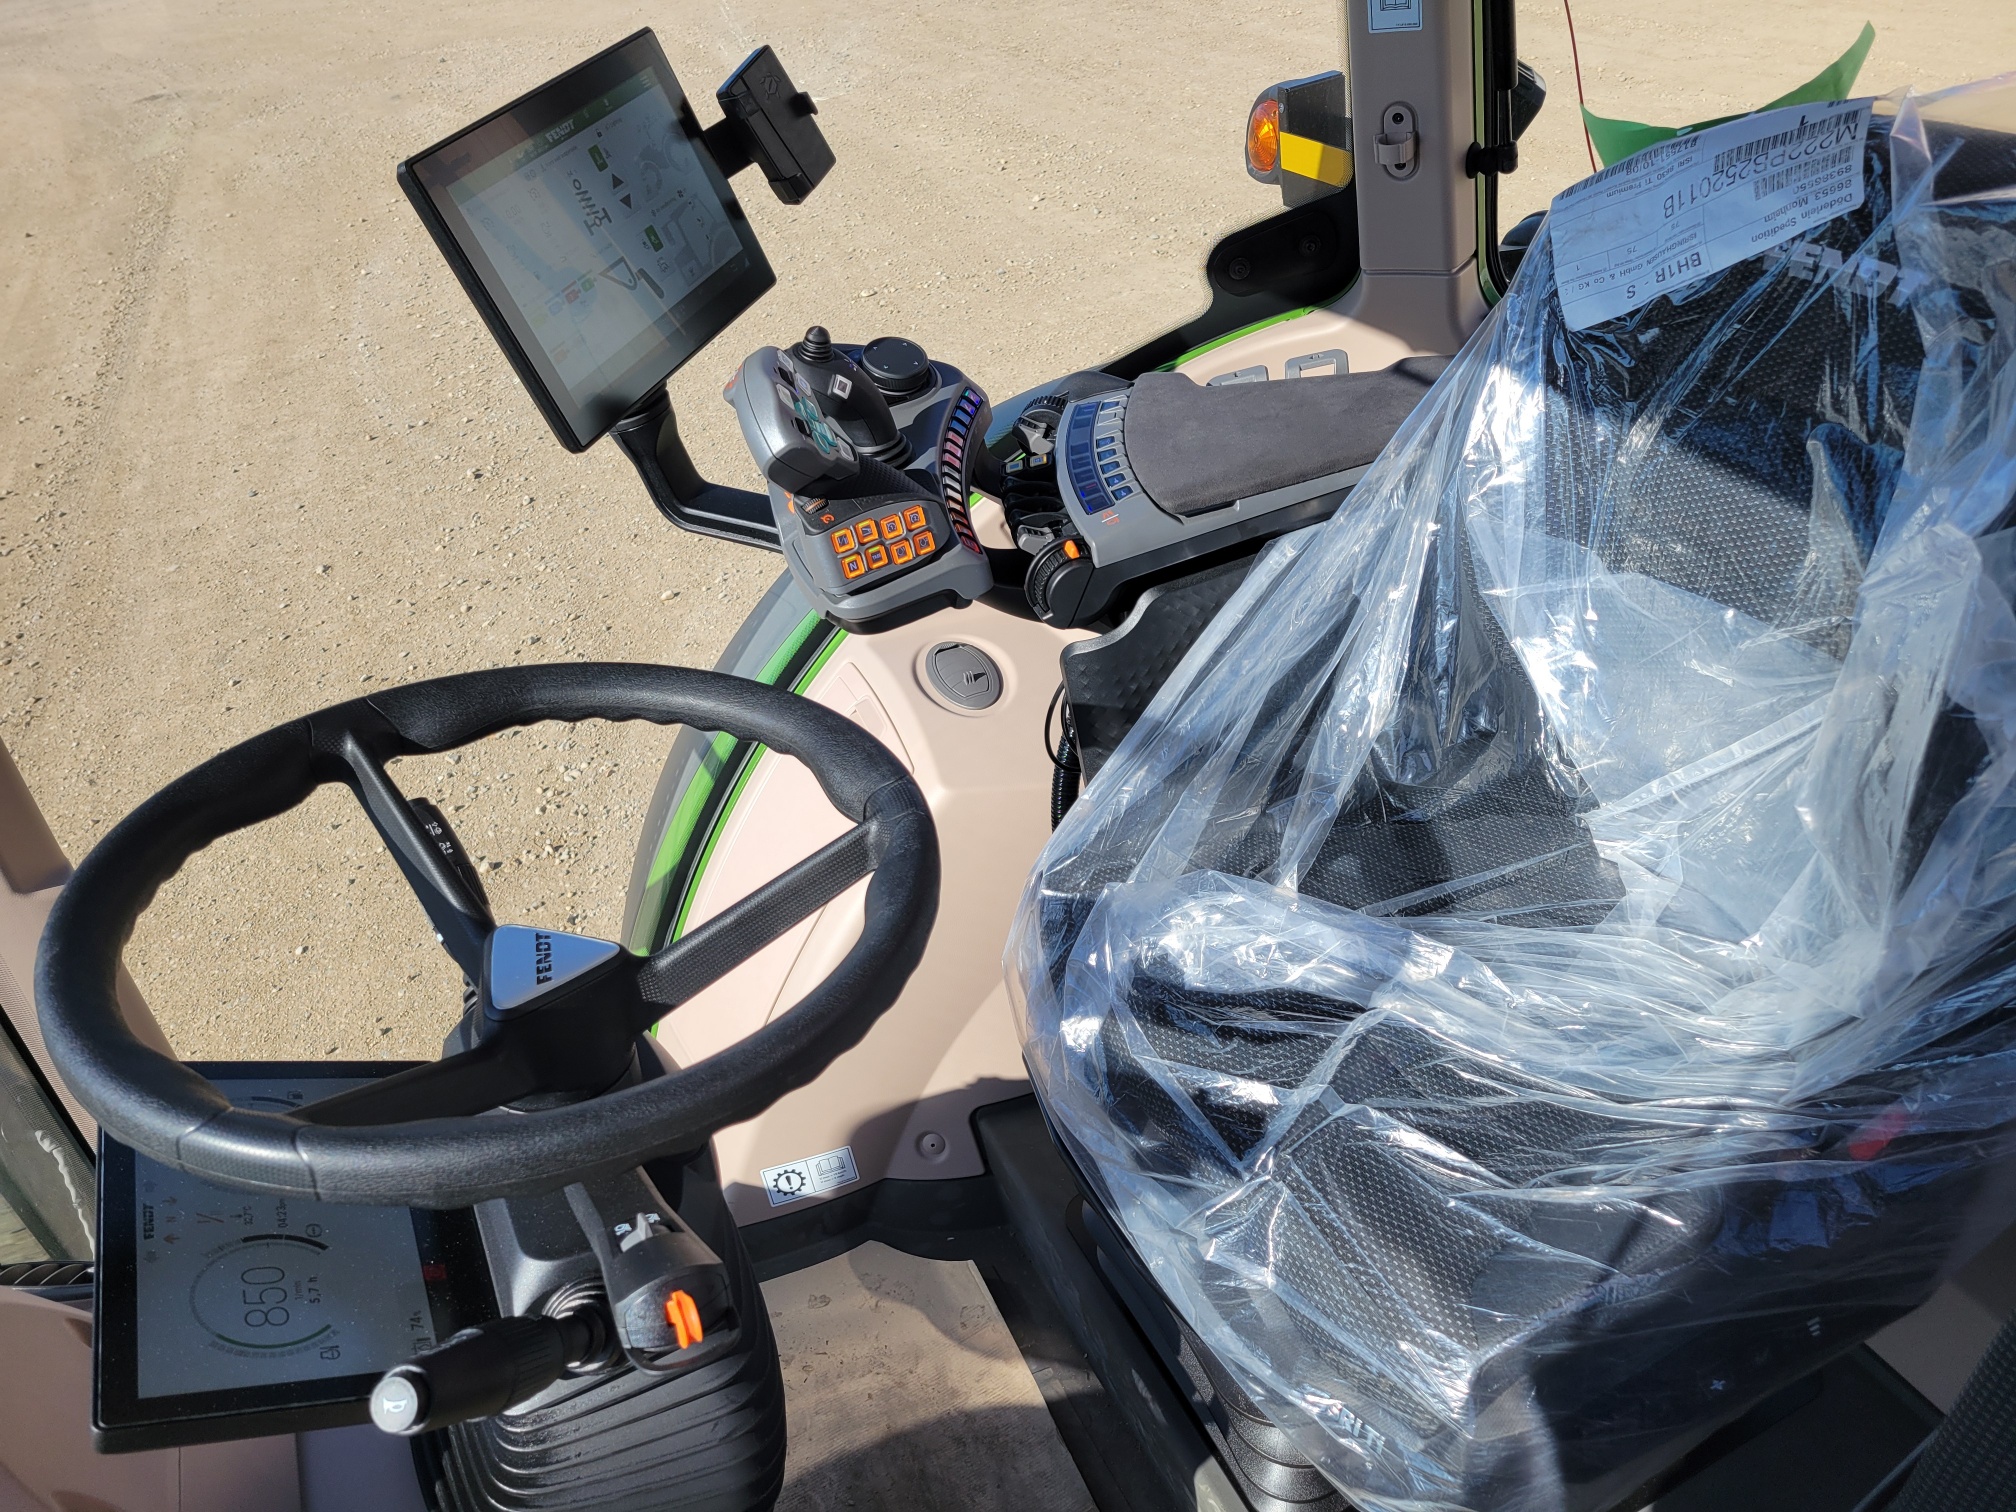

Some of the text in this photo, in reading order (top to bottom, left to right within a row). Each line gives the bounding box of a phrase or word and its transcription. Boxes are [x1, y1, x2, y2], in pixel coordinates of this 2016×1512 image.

[545, 119, 576, 143] FENDT
[1644, 177, 1653, 185] Ti
[1663, 123, 1859, 219] M222PS252011B
[1606, 182, 1642, 198] Premium
[1814, 179, 1852, 200] 86653
[1763, 196, 1809, 223] Monheim
[1801, 193, 1853, 219] Döderlein
[1751, 217, 1797, 243] Spedition
[1626, 246, 1637, 255] 75
[1646, 232, 1697, 265] ISRINGHAUSEN
[1594, 276, 1605, 284] Co
[1619, 263, 1643, 277] GmbH
[1655, 251, 1702, 284] BH1R
[1578, 282, 1590, 291] KG
[1626, 284, 1636, 300] S
[535, 933, 552, 985] FENDT
[143, 1203, 155, 1240] FENDT
[241, 1266, 290, 1328] 850
